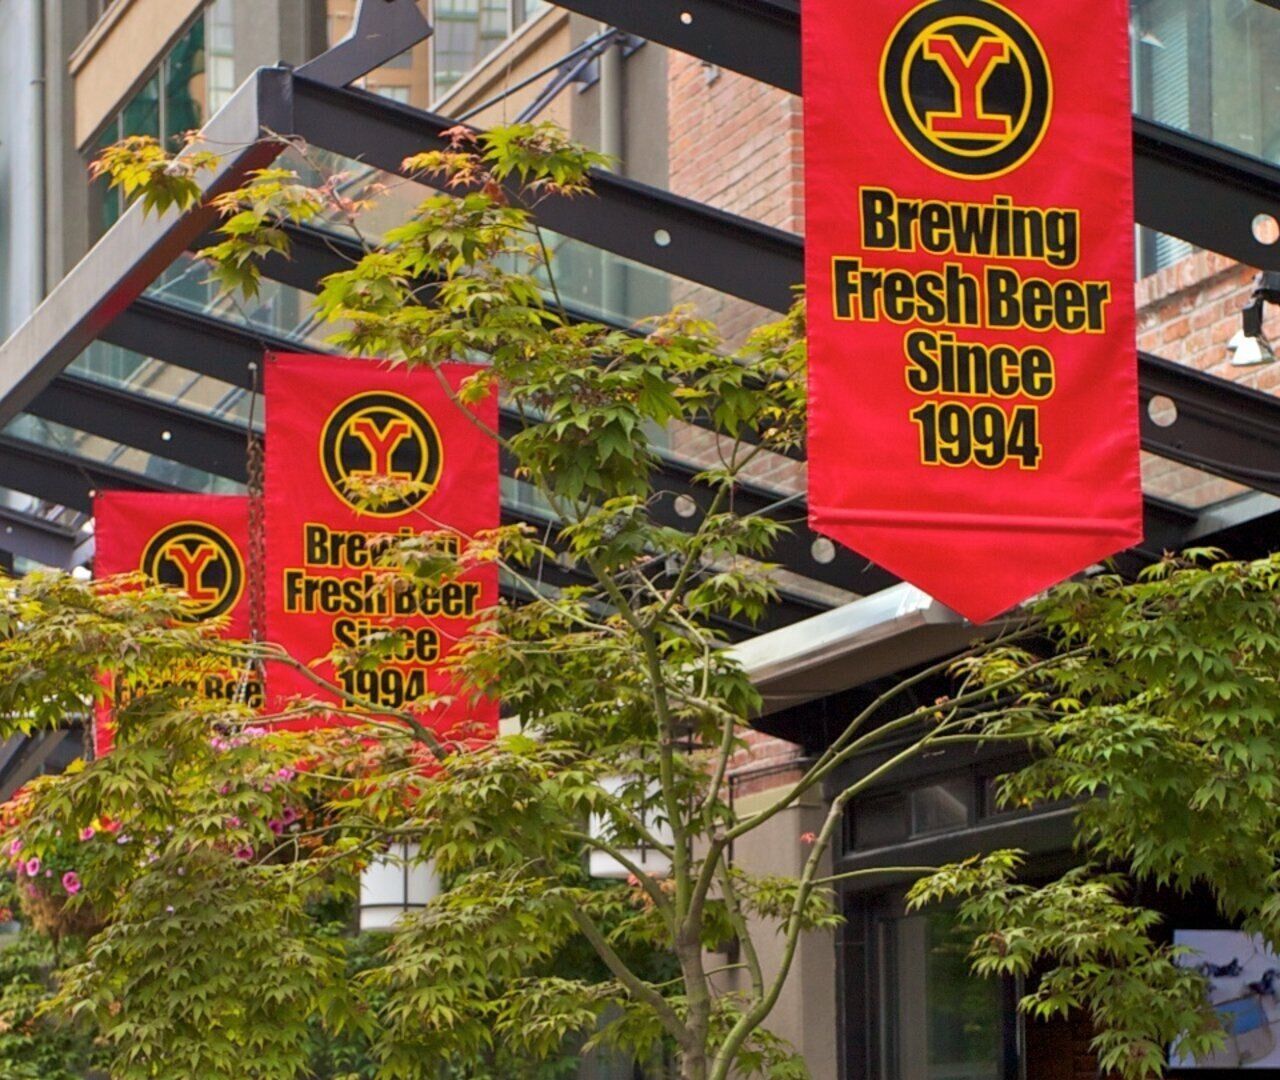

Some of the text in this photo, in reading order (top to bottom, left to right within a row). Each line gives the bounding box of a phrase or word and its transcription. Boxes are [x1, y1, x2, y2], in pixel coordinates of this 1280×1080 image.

[859, 187, 1079, 268] Brewing
[831, 256, 1110, 334] Fresh Beer
[904, 329, 1055, 401] Since
[910, 401, 1042, 470] 1994
[284, 568, 389, 616] Fresh
[336, 666, 427, 714] 1994
